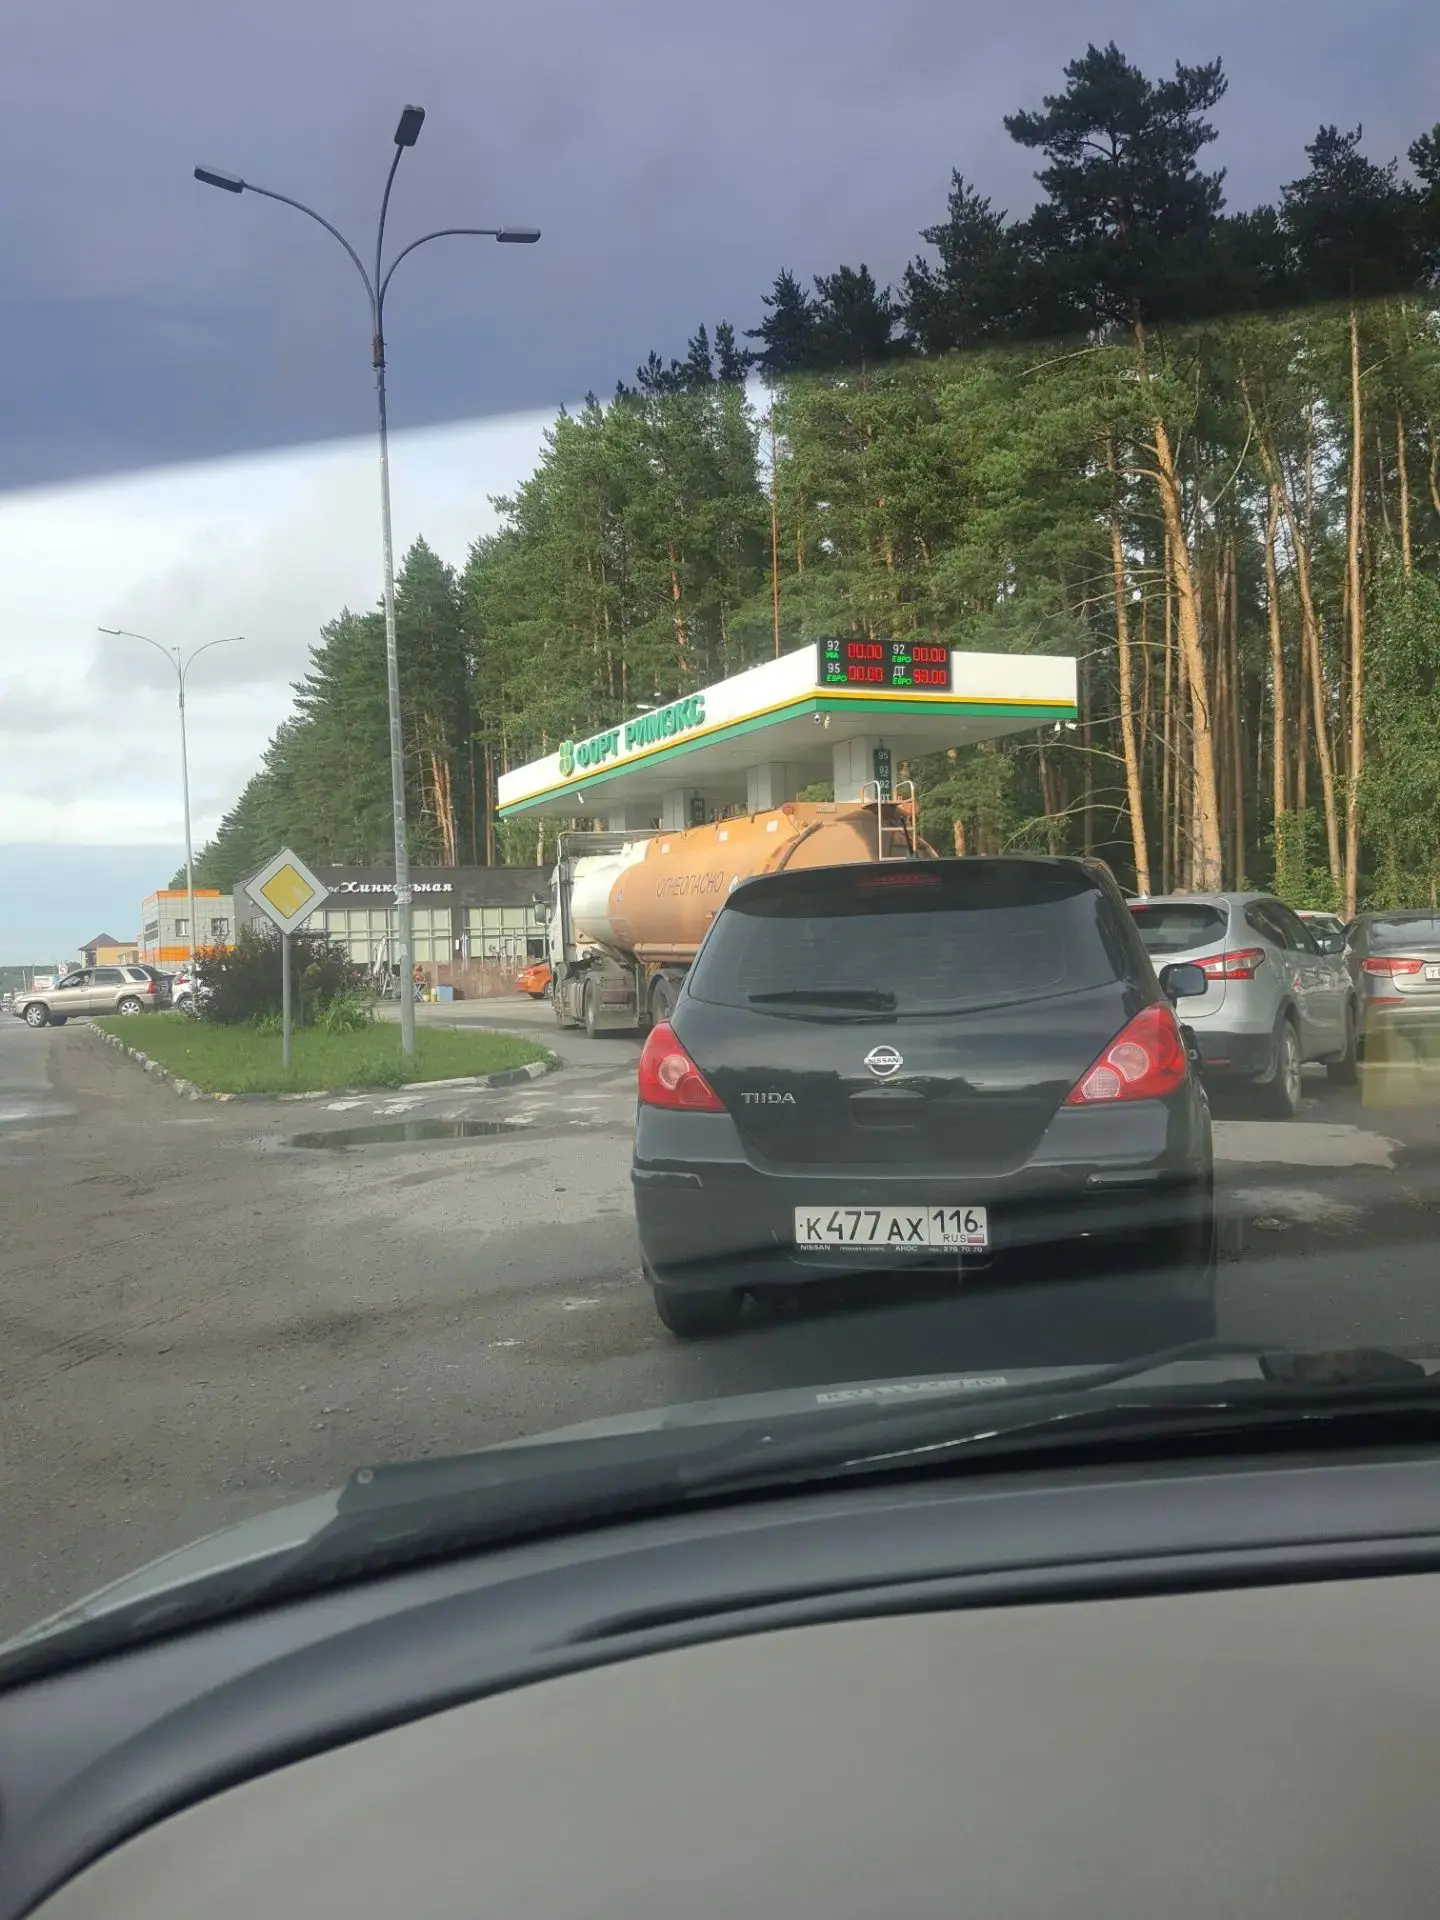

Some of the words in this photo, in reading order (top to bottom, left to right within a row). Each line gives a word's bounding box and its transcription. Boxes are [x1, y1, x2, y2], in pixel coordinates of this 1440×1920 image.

[827, 640, 840, 652] 92
[893, 644, 905, 655] 92
[828, 663, 841, 674] 95
[893, 666, 906, 678] ДТ
[576, 729, 620, 768] ФОРТ
[624, 694, 706, 751] РИМЭКС
[340, 881, 454, 893] Хинкьная
[656, 871, 724, 898] ОГНЕОПАСНО
[867, 1056, 900, 1065] NISSAN
[740, 1092, 796, 1105] TIIDA
[932, 1209, 979, 1234] 116
[943, 1234, 966, 1243] RUS
